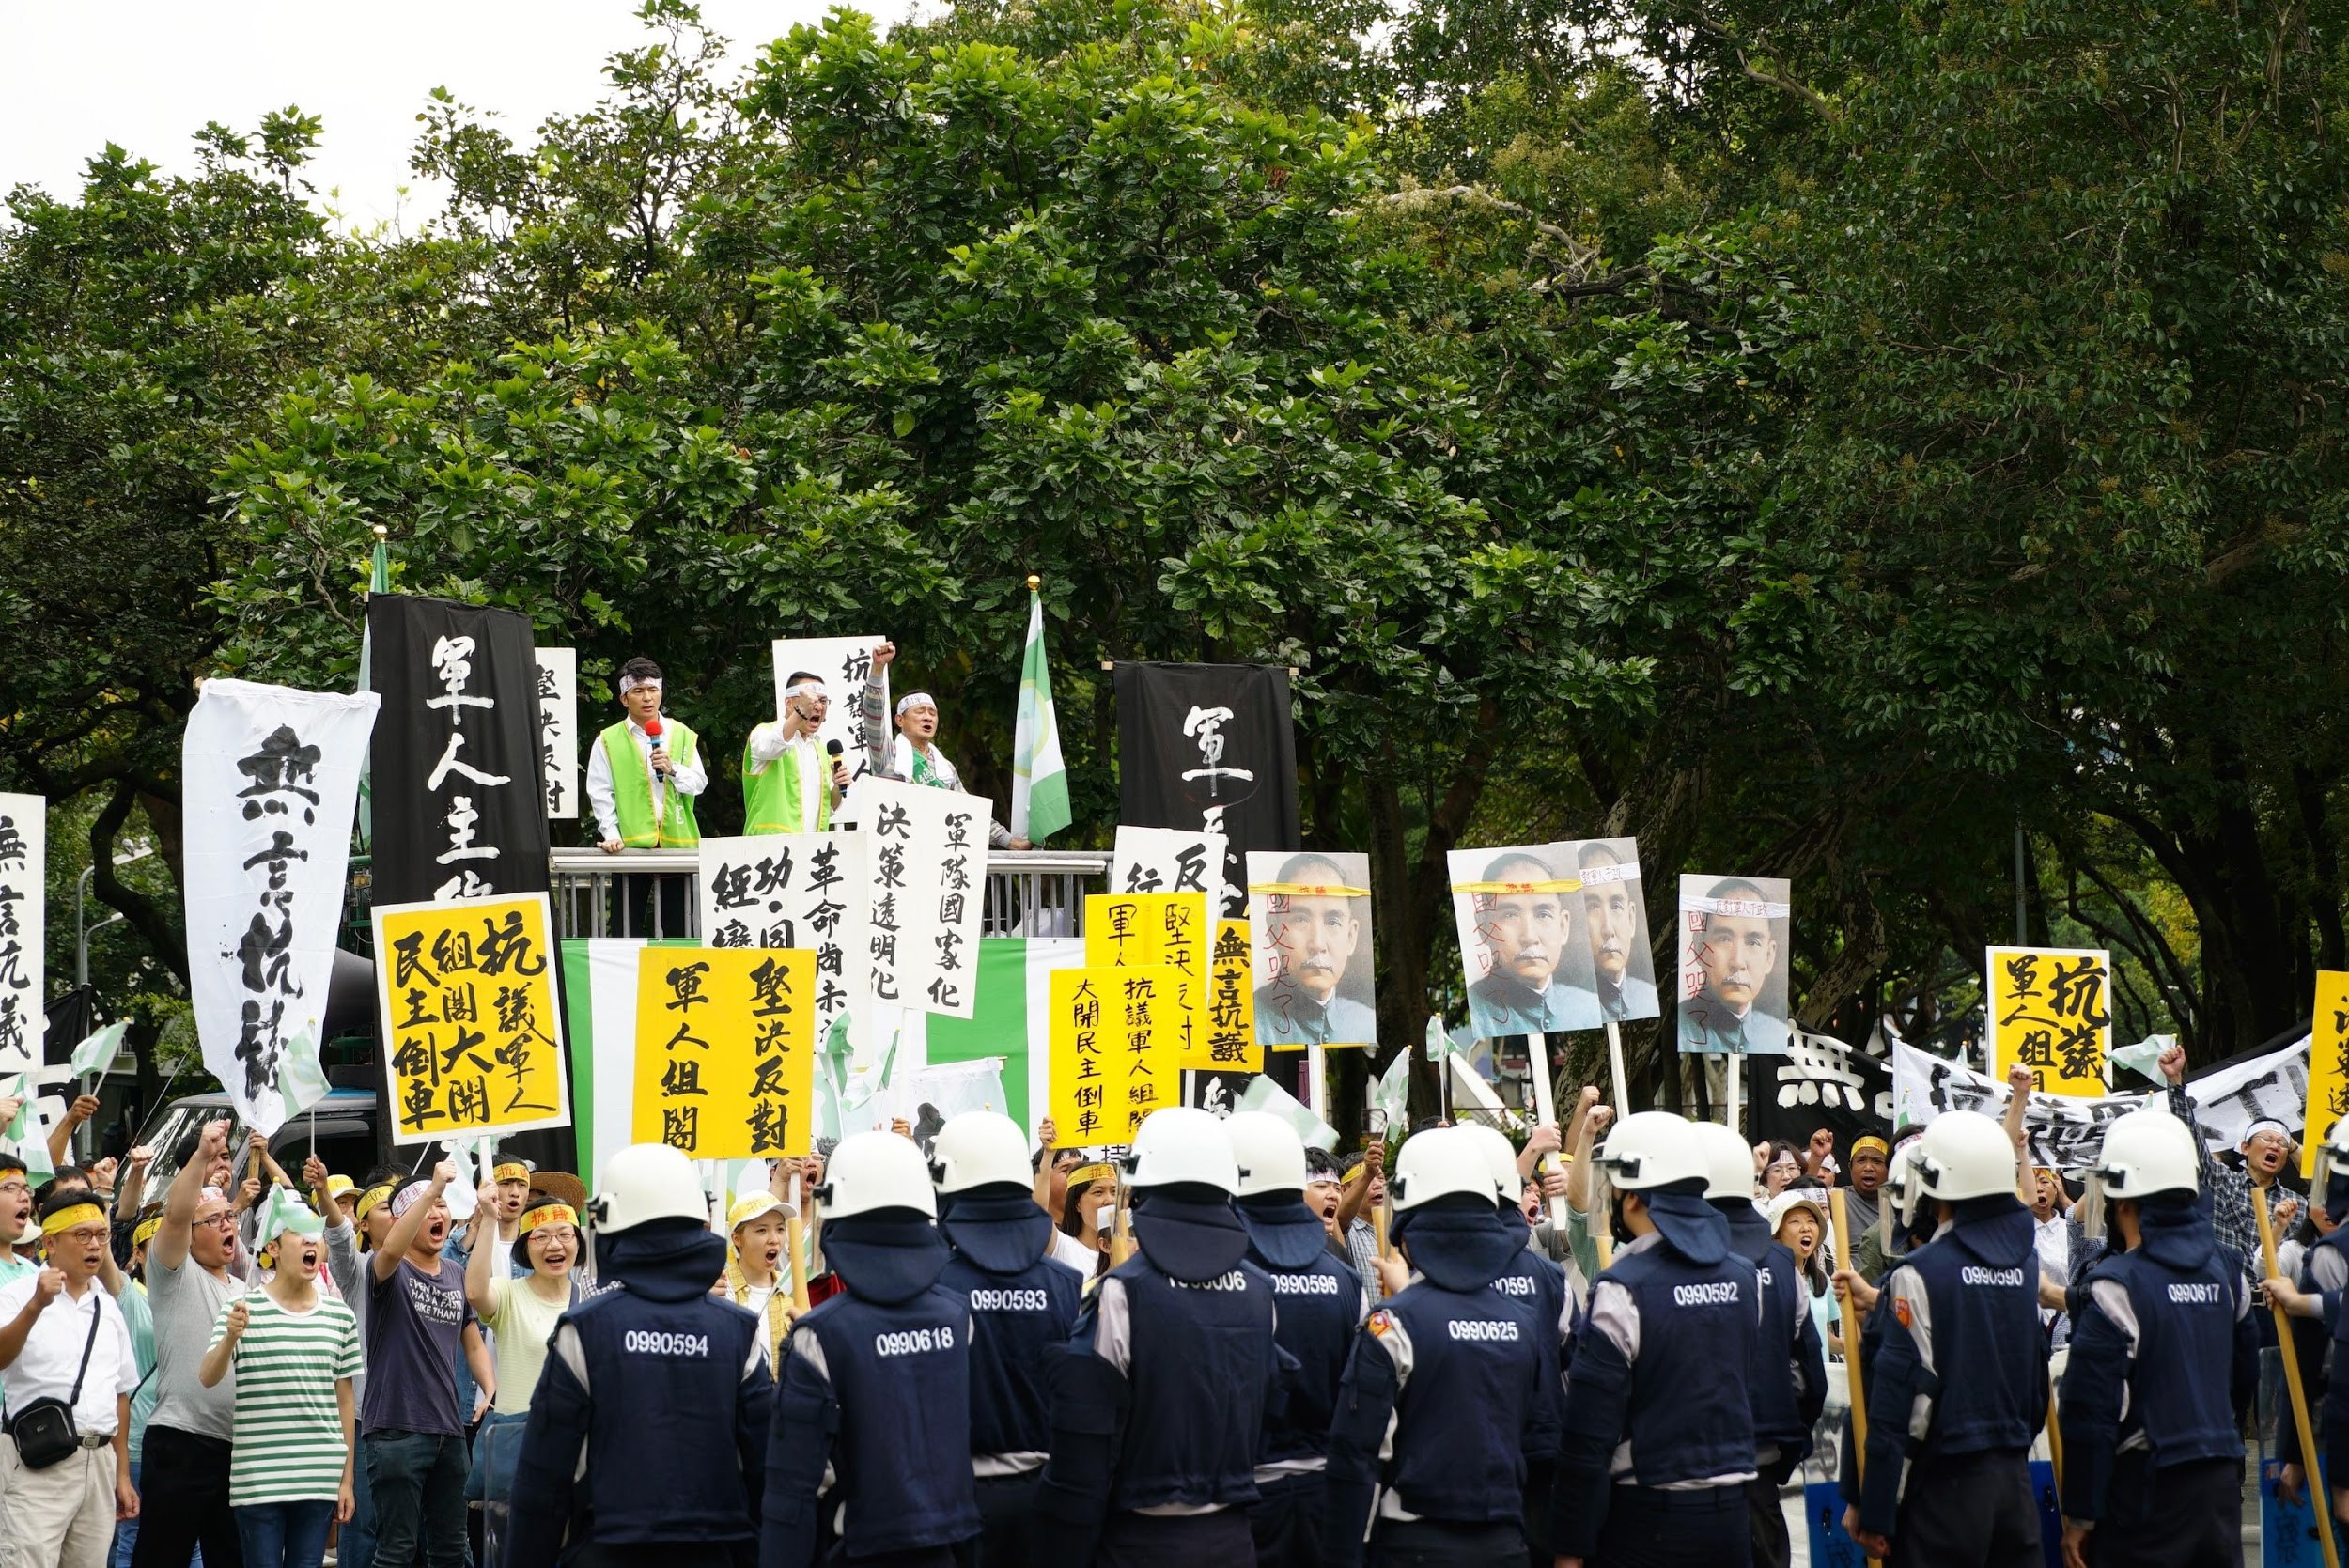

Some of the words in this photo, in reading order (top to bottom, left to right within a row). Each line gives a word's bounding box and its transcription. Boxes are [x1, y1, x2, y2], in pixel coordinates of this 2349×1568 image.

[802, 841, 848, 1043] 革命尚未
[869, 801, 911, 1001] 決策透明化
[927, 812, 972, 1008] 軍隊國家化
[1263, 893, 1298, 1034] 國父哭了
[1471, 891, 1513, 1024] 國父哭了
[391, 930, 446, 1131] 民主倒車
[430, 928, 495, 1124] 組閣大開
[476, 911, 558, 1113] 抗議軍人
[1207, 926, 1251, 1063] 無言抗議
[1685, 910, 1714, 1045] 國父哭了
[2047, 956, 2113, 1094] 抗議
[661, 961, 710, 1153] 軍人組閣
[746, 956, 793, 1154] 堅決反對
[1071, 979, 1104, 1137] 大開民主倒車
[411, 1288, 430, 1303] HAS
[433, 1307, 456, 1321] THAN
[625, 1330, 709, 1357] 0990594
[876, 1326, 955, 1357] 0990618
[970, 1289, 1048, 1312] 0990593
[1448, 1320, 1519, 1341] 0990625
[1673, 1281, 1740, 1306] 0990592
[1962, 1266, 2024, 1287] 0990590
